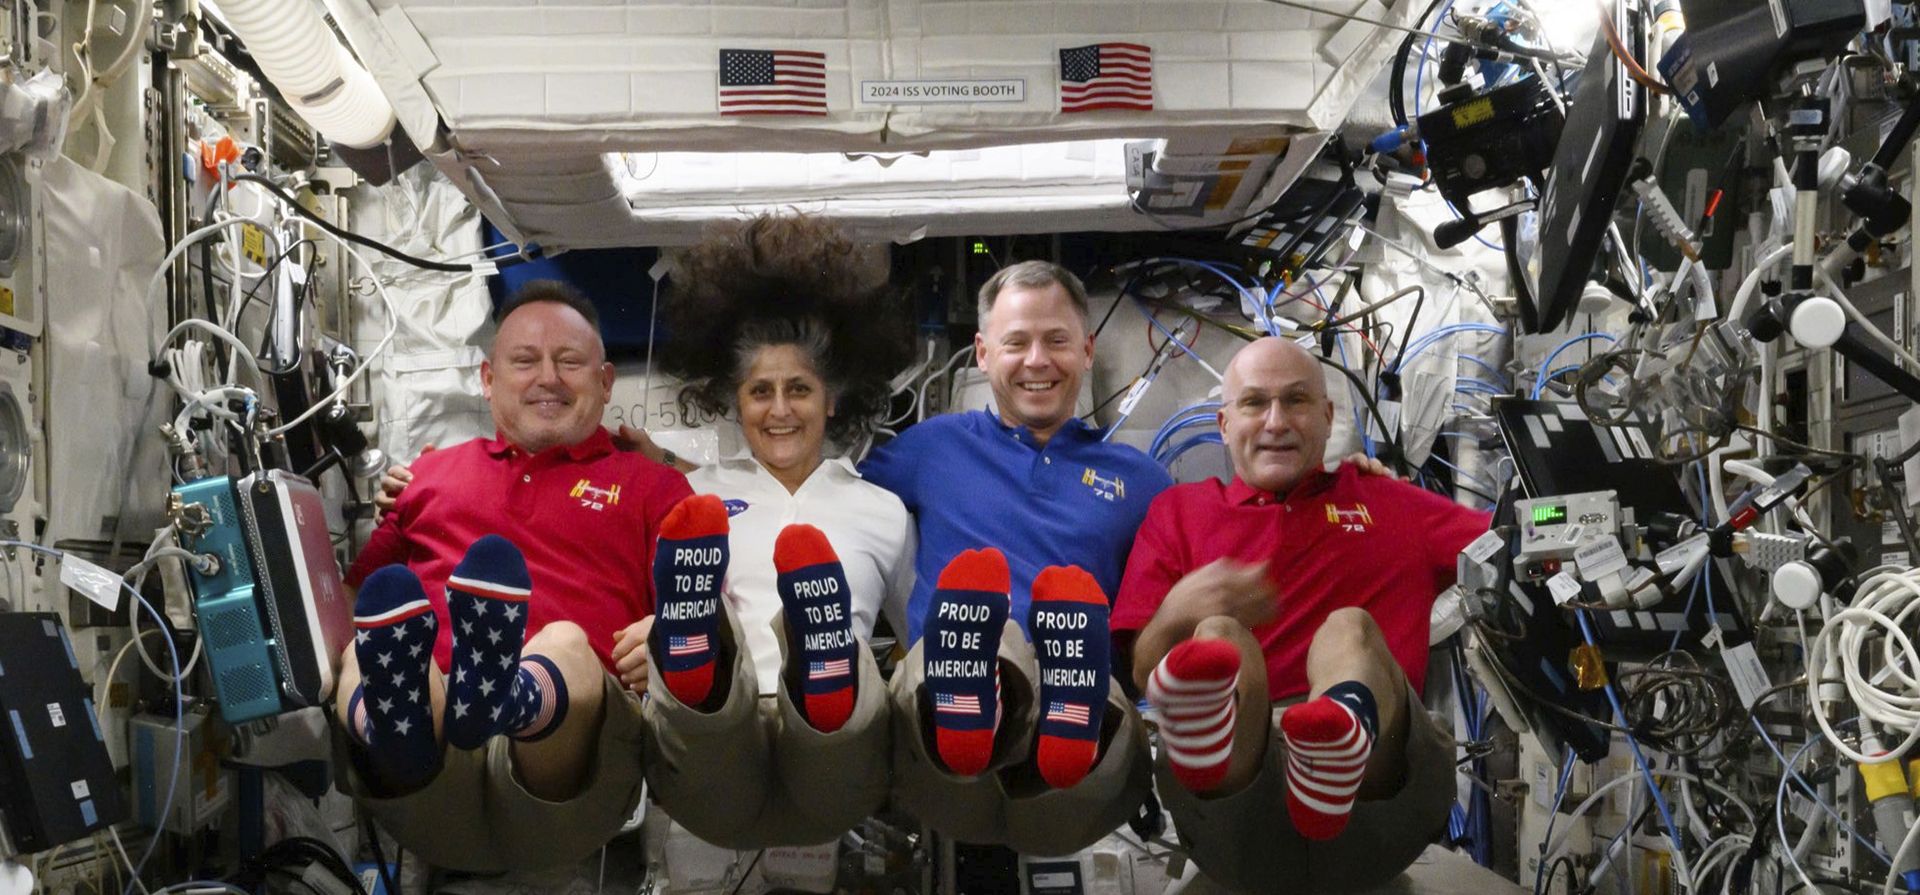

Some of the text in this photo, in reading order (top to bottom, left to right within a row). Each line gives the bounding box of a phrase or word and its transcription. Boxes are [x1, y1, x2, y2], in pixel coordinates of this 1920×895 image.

[870, 85, 1016, 97] 2024 ISS VOTING BOOTH
[674, 547, 722, 566] PROUD
[674, 574, 714, 592] TO BE
[793, 576, 839, 599] PROUD
[661, 598, 718, 620] AMERICAN
[804, 602, 843, 624] TO BE
[938, 601, 991, 622] PROUD
[1036, 610, 1088, 630] PROUD
[939, 630, 982, 650] TO BE
[1044, 639, 1084, 658] TO BE
[927, 660, 988, 678] AMERICAN
[1042, 668, 1096, 687] AMERICAN
